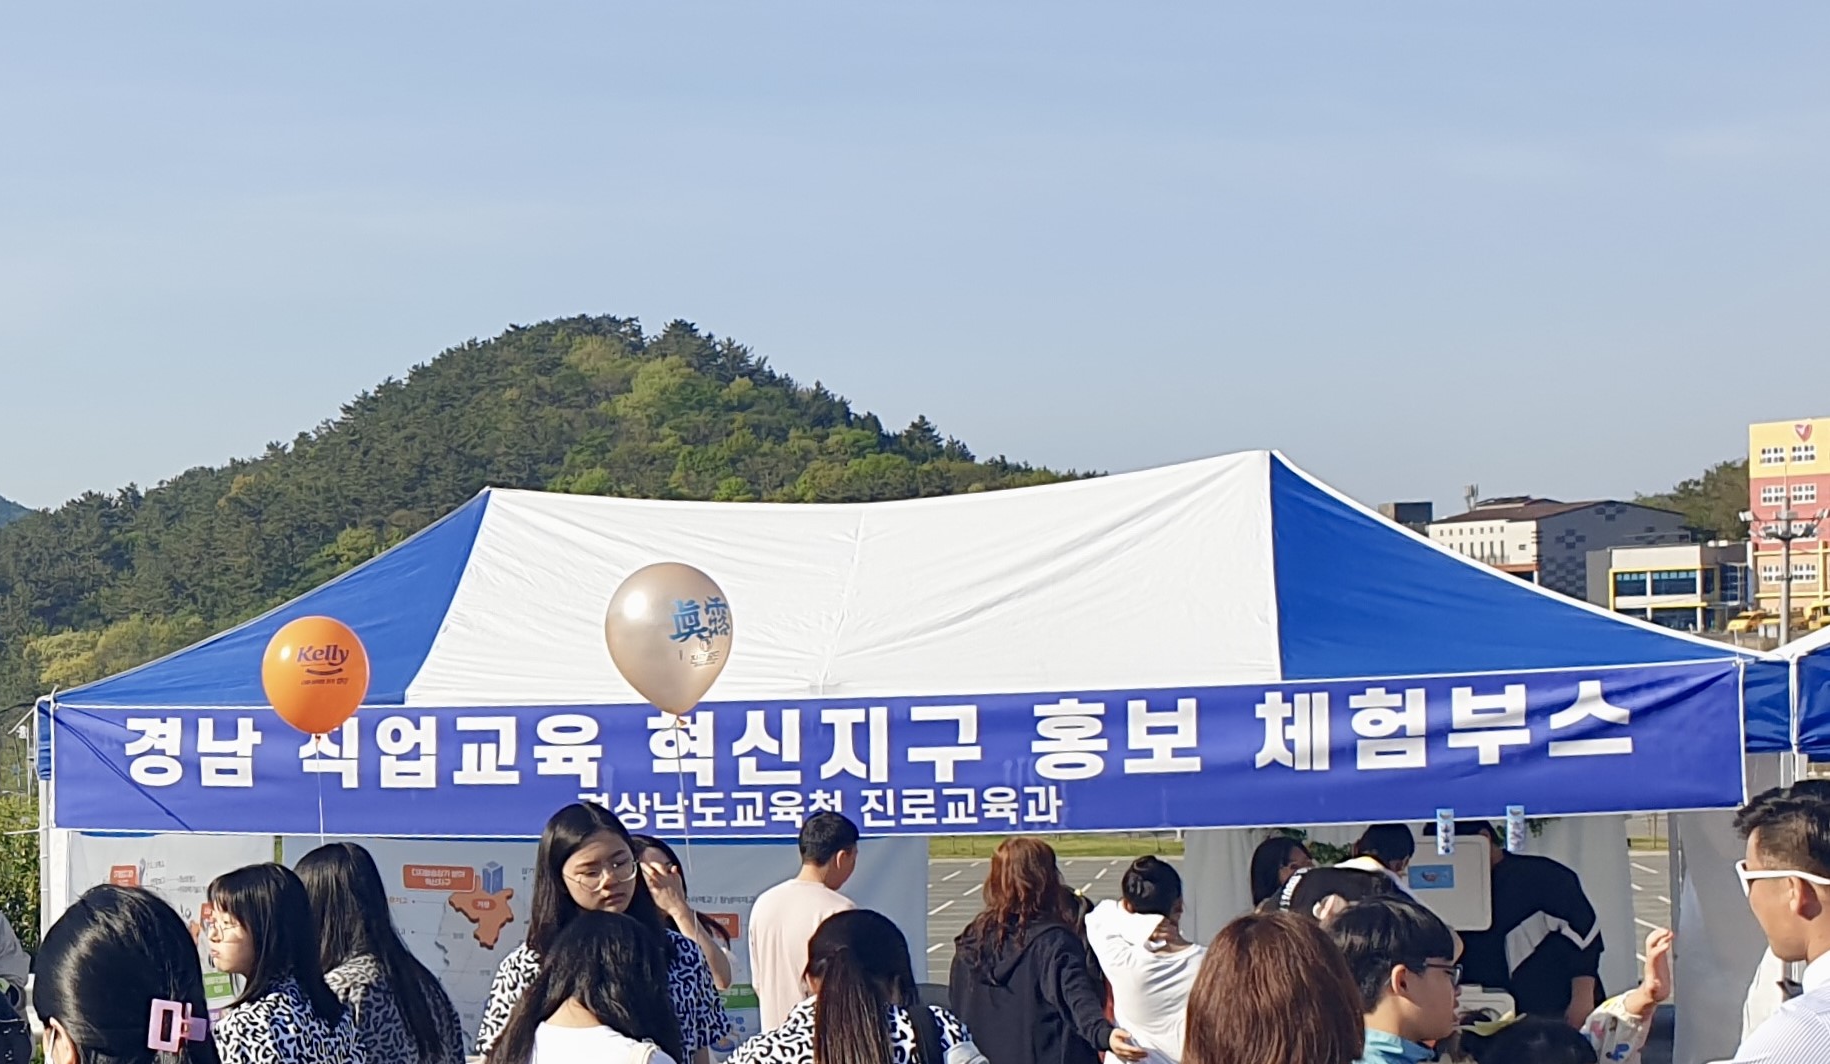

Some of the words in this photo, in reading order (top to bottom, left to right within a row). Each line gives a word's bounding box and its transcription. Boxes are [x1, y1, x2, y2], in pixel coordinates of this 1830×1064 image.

[296, 644, 350, 667] Kelly
[125, 716, 263, 788] 경남
[646, 704, 982, 788] 혁신지구
[1031, 698, 1202, 781] 홍보
[1255, 680, 1633, 771] 체험부스
[860, 785, 1063, 828] 진로교육과
